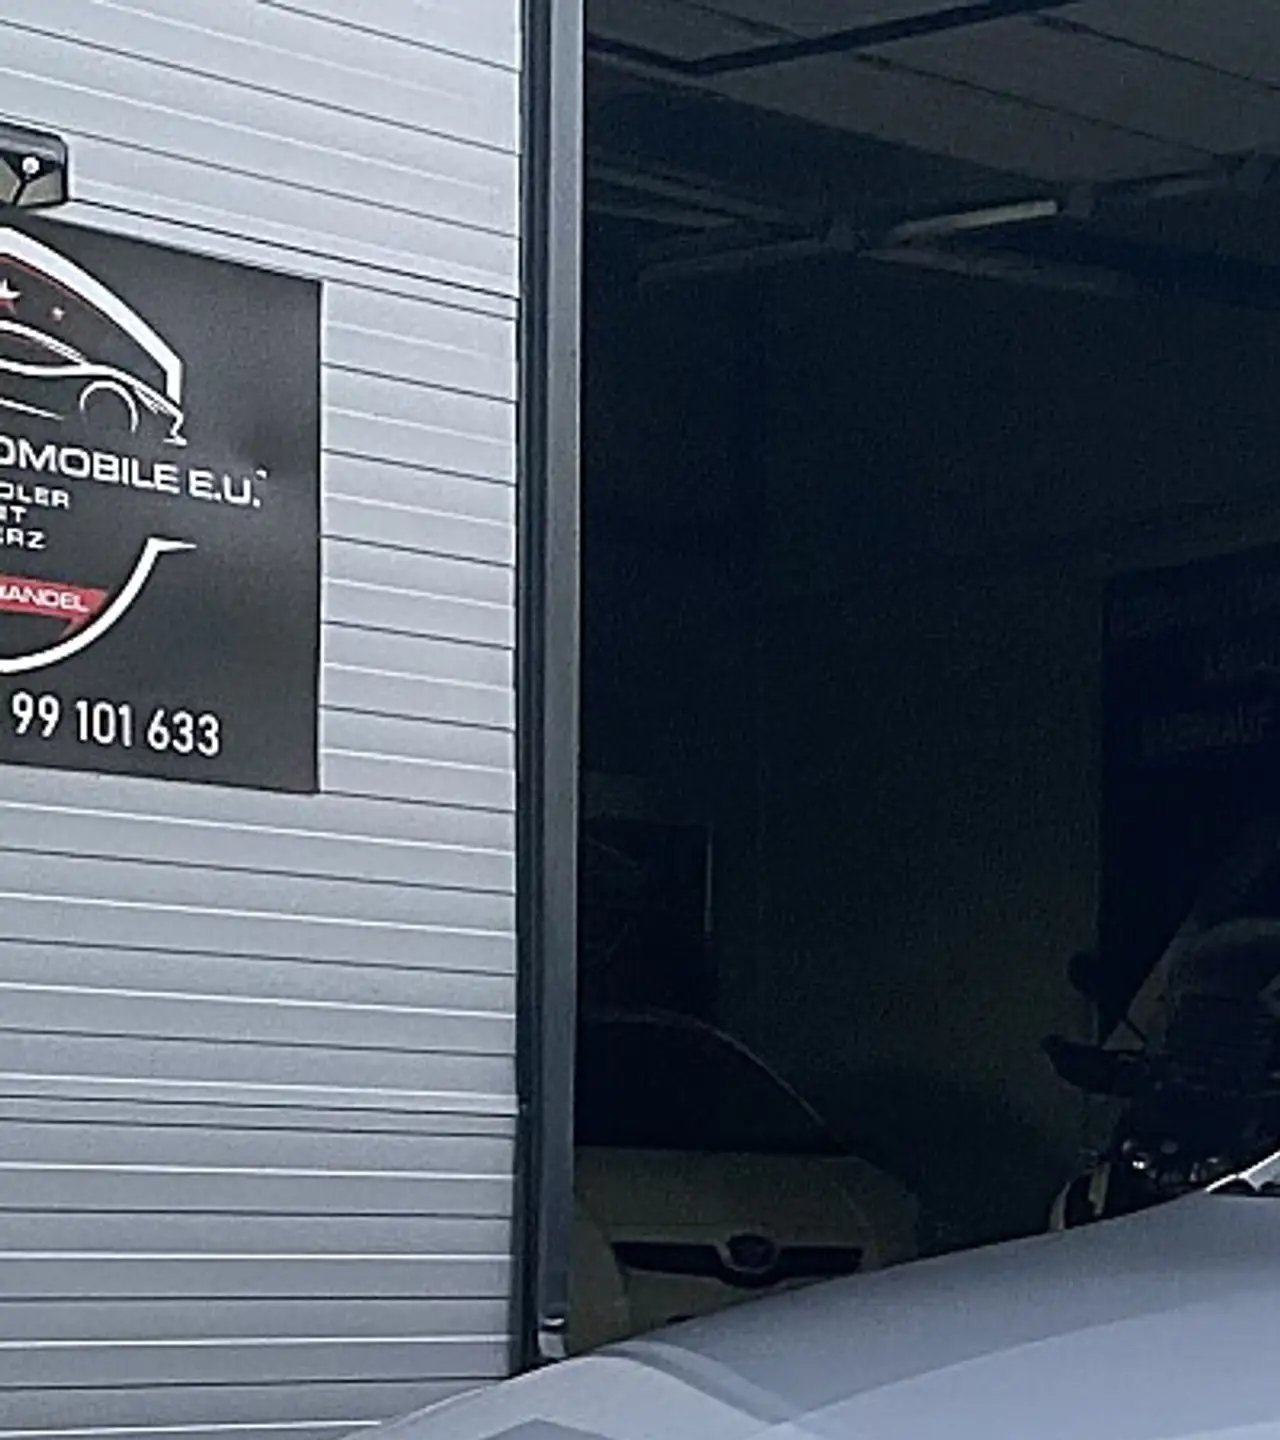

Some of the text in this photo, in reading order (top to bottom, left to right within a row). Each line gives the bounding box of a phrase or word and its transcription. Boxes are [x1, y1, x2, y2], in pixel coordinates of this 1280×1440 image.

[0, 526, 47, 549] RZ
[11, 690, 221, 757] 99 101 633
